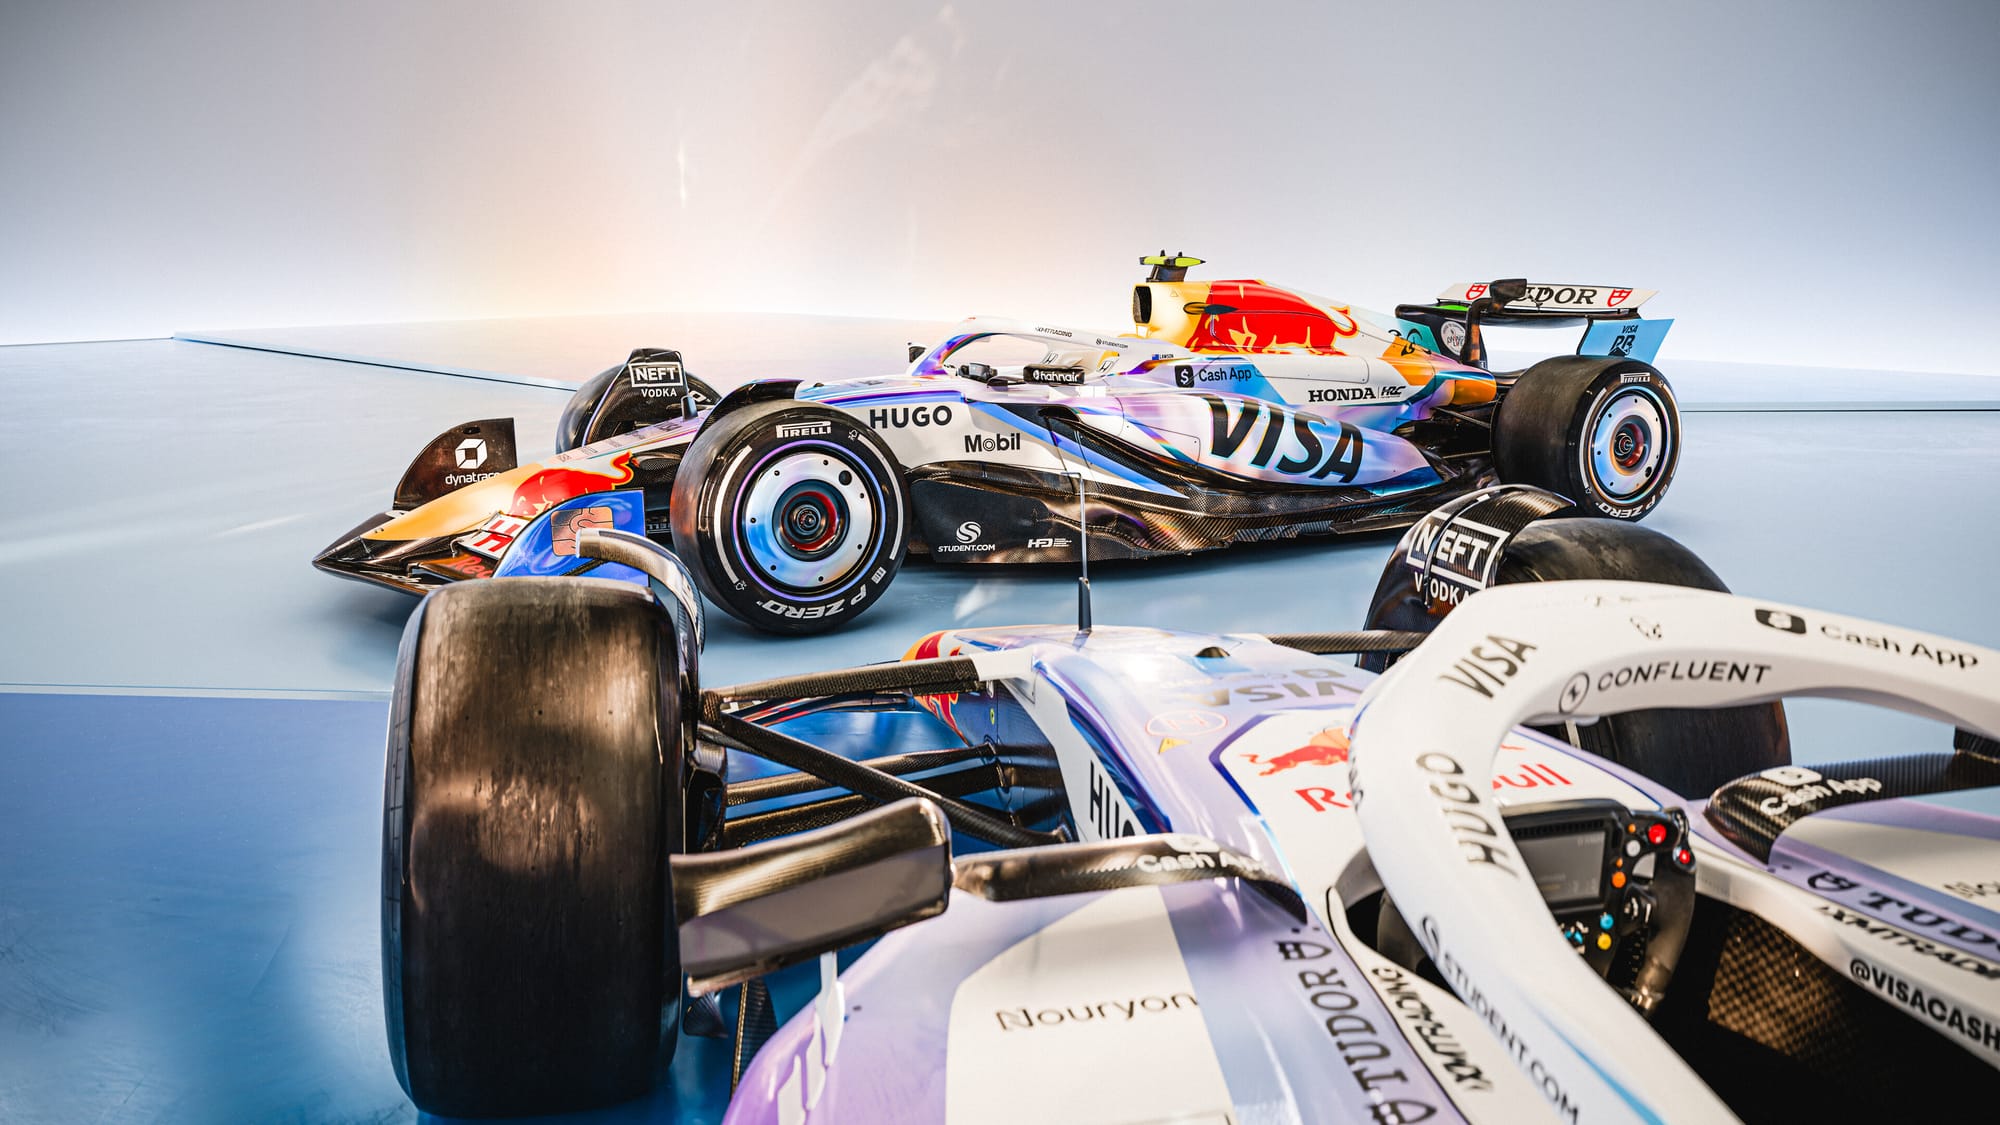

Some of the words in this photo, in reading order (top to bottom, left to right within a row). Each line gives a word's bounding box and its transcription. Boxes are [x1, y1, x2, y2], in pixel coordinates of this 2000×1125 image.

[1622, 325, 1639, 334] VISA
[635, 367, 676, 381] NEFT
[1040, 370, 1080, 384] hahnair
[1198, 367, 1227, 382] Cash
[1229, 367, 1252, 381] App
[1620, 372, 1651, 384] PIRELLI
[641, 387, 678, 398] VODKA
[1308, 386, 1376, 402] HONDA
[869, 405, 953, 429] HUGO
[776, 421, 831, 439] PIRELLI
[1203, 397, 1363, 484] VISA
[964, 433, 1021, 453] Mobil
[1599, 502, 1643, 518] ZERO
[938, 544, 996, 553] STUDENT.COM
[1415, 523, 1490, 571] NEFT
[850, 584, 867, 606] P
[761, 598, 845, 619] ZERO
[1821, 624, 1900, 653] Cash
[1911, 643, 1979, 669] App
[1438, 635, 1537, 698] VISA
[1597, 661, 1772, 692] CONFLUENT
[1759, 784, 1832, 816] Cash
[1826, 776, 1882, 795] App
[1415, 752, 1520, 878] HUGO
[1136, 852, 1216, 874] Cash
[1858, 891, 2000, 955] TUD
[994, 991, 1199, 1033] Nouryon
[1297, 966, 1409, 1093] TUDOR
